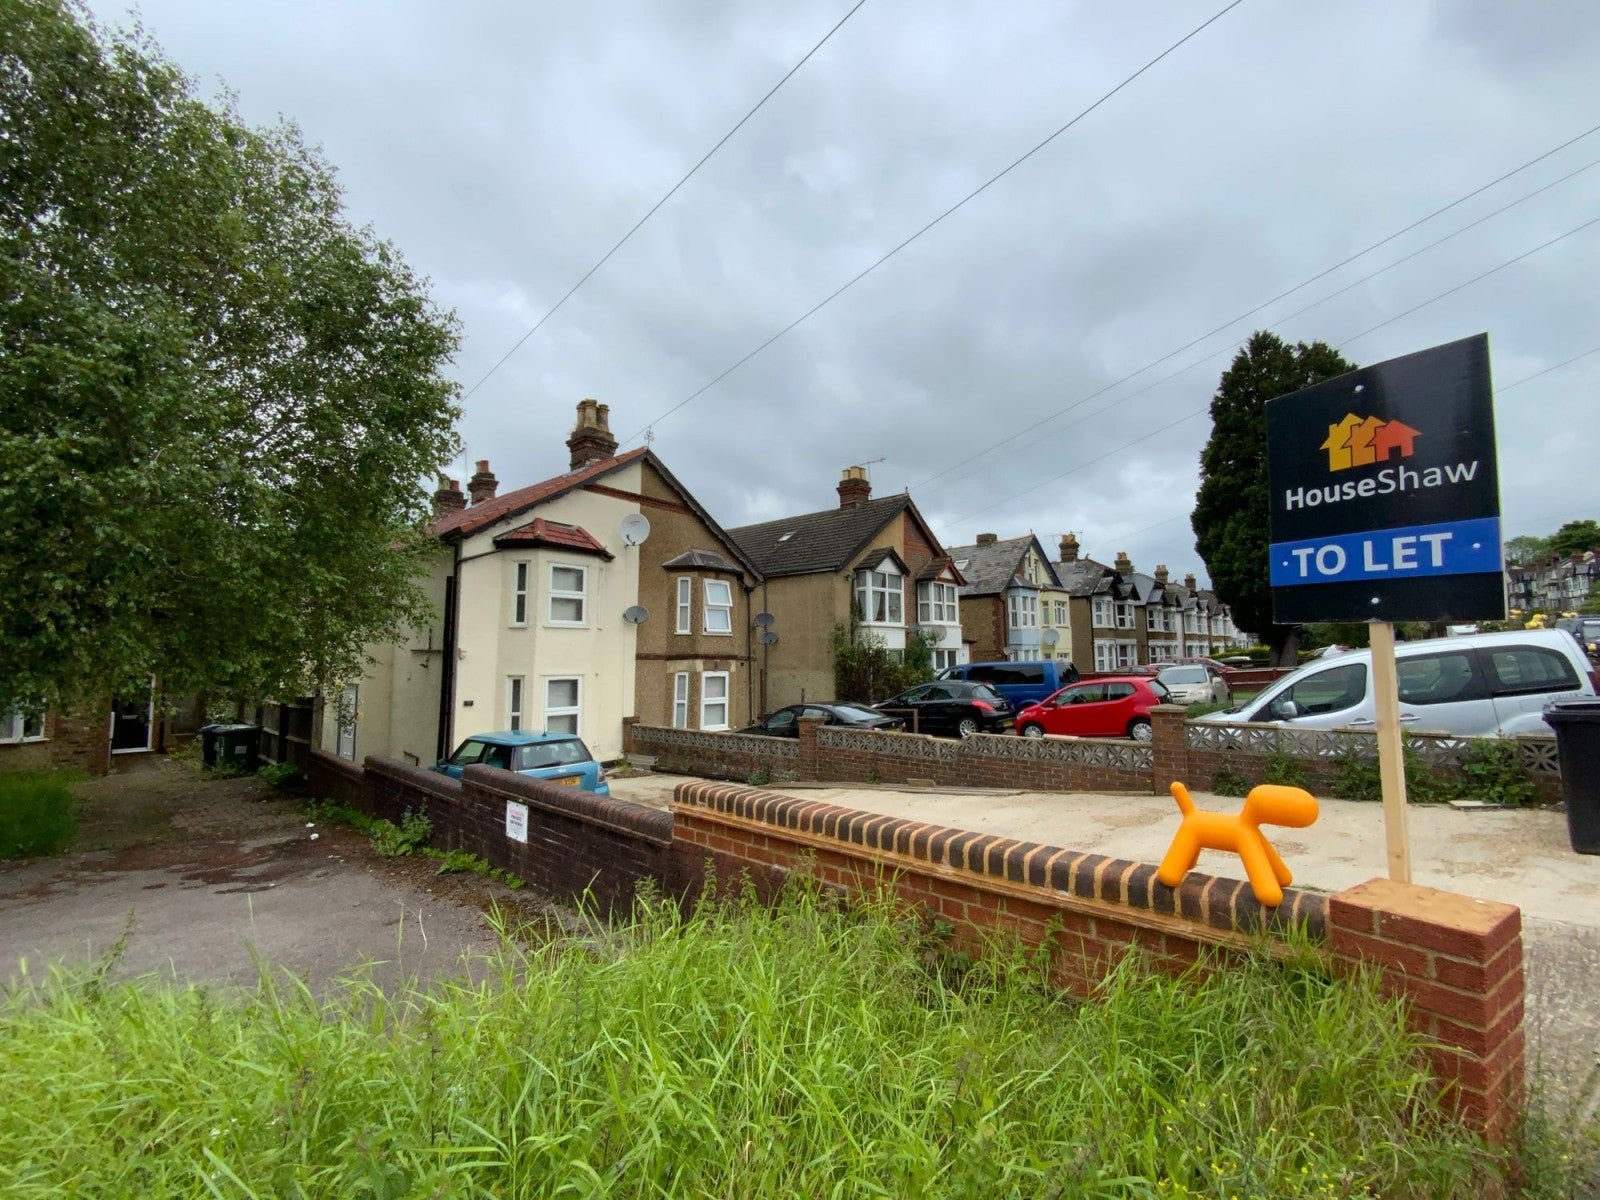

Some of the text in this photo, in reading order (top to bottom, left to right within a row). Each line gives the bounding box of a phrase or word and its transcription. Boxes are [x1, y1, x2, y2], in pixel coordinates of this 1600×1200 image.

[1285, 460, 1478, 511] HouseShaw
[1292, 532, 1453, 577] TO LET
